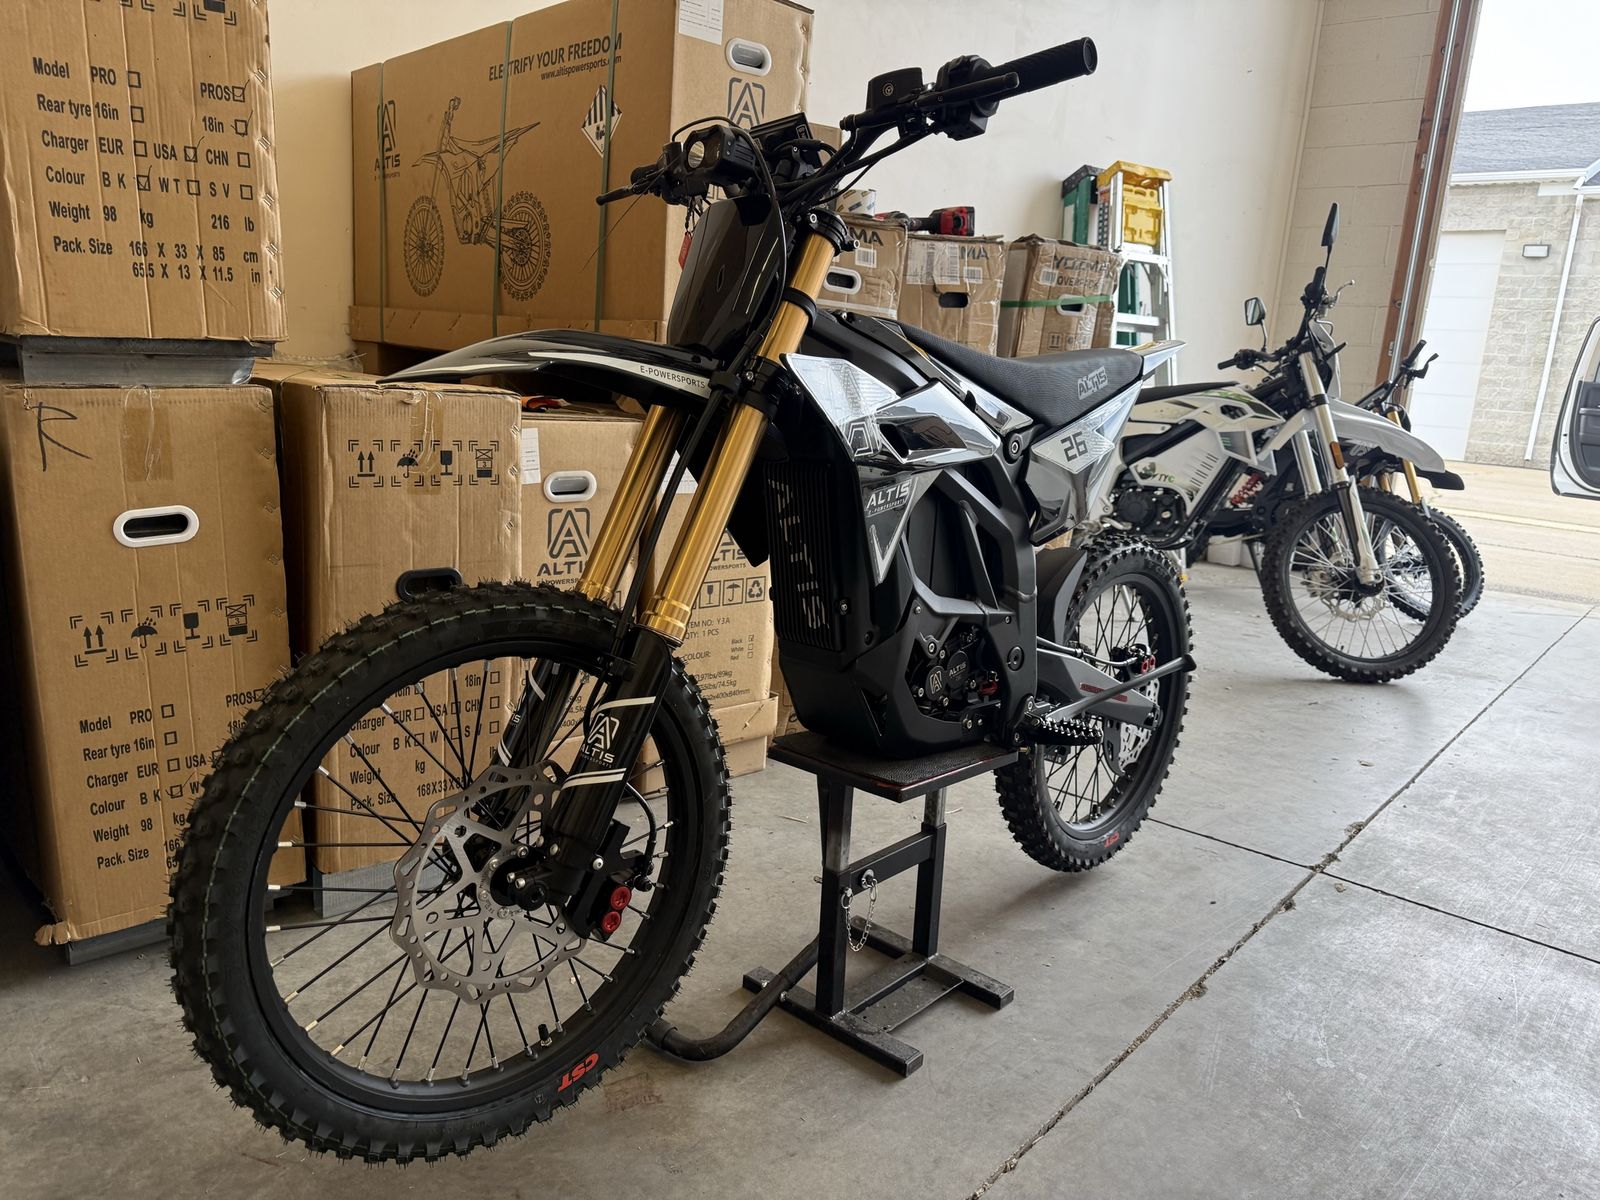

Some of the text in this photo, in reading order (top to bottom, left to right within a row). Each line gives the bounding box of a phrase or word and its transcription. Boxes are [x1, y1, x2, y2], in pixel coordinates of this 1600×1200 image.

[33, 57, 117, 86] Model PRO
[488, 55, 536, 81] ELETRIFY
[536, 47, 565, 69] YOUR
[200, 82, 231, 102] PROS
[37, 94, 119, 121] Rear tyre 16in
[202, 116, 224, 133] 18in
[41, 130, 229, 166] Charger EUR USA CHN
[45, 166, 85, 185] Colour
[49, 201, 255, 232] Weight 98 kg 216 lb
[53, 236, 86, 254] Pack.
[88, 239, 113, 255] Size
[129, 241, 148, 257] 166
[174, 243, 188, 259] 33
[212, 246, 225, 261] 85
[243, 250, 259, 264] cm
[132, 262, 155, 279] 65.5
[178, 264, 191, 280] 13
[212, 267, 234, 283] 11.5
[251, 269, 261, 284] in
[640, 364, 706, 389] E-POWERSPORTS
[1078, 368, 1108, 398] ALTIS
[1061, 431, 1088, 462] 26
[867, 482, 911, 508] ALTIS
[537, 561, 584, 576] ALTI
[465, 674, 481, 688] 18in
[79, 708, 153, 734] Model PRO
[83, 737, 155, 762] Rear tyre 16in
[580, 742, 616, 764] ALTIS
[87, 753, 207, 790] Charger EUR USA
[415, 760, 426, 774] kg
[90, 799, 125, 816] Colour
[93, 812, 186, 843] Weight 98 kg
[97, 838, 181, 870] Pack. Size 166
[558, 1053, 599, 1093] CST
